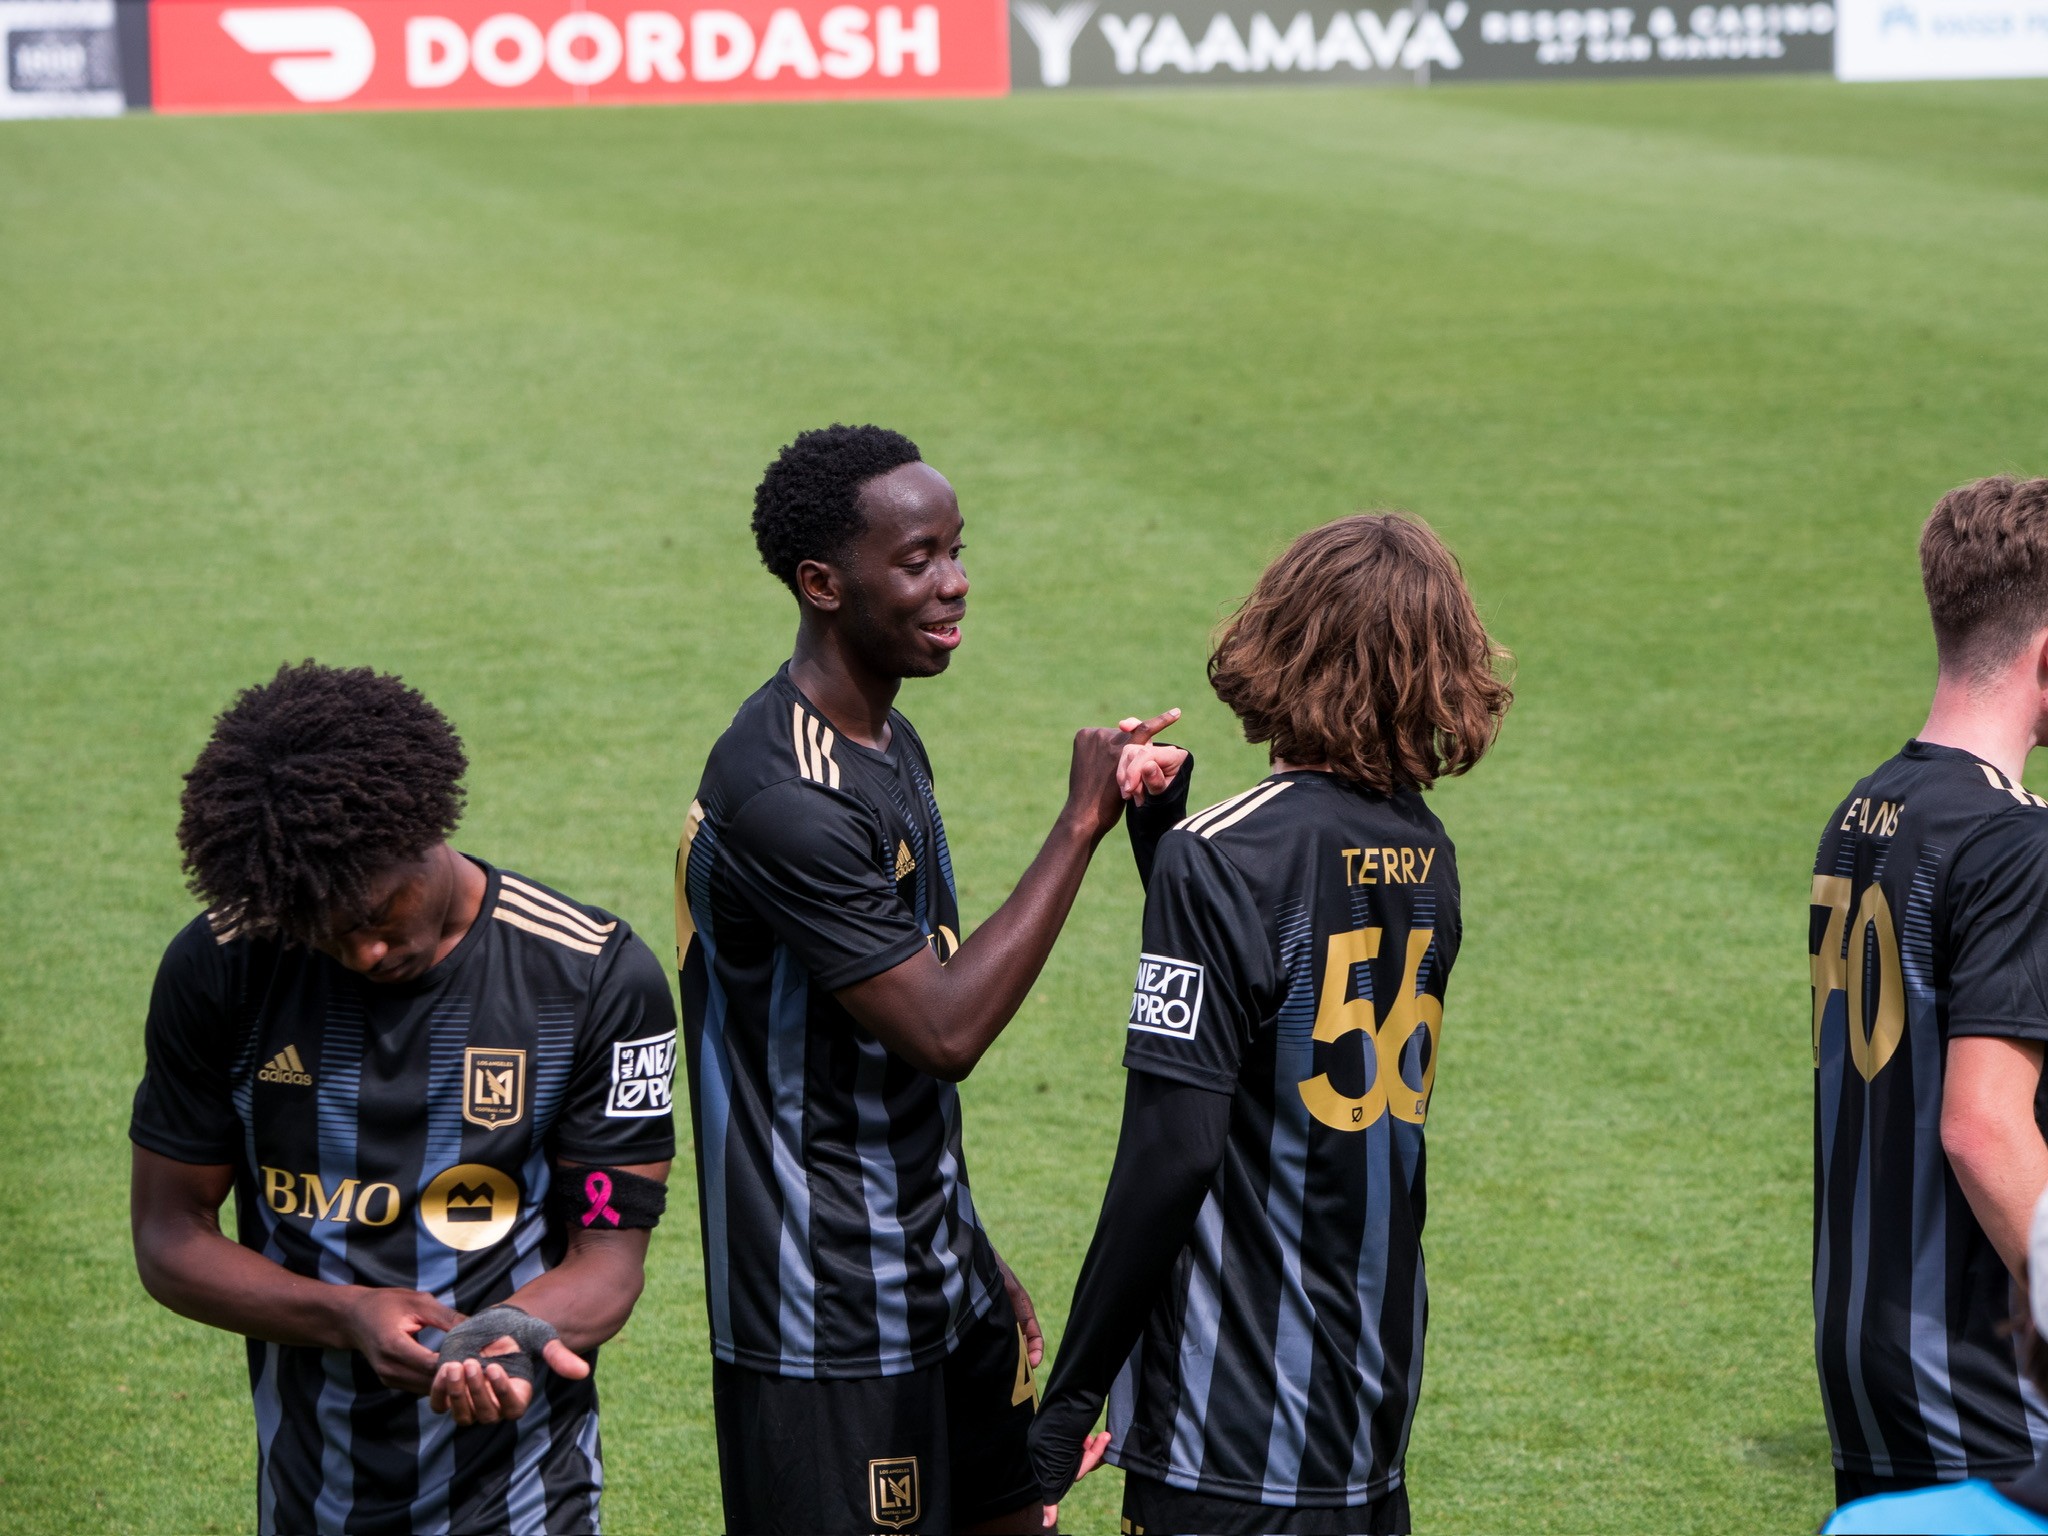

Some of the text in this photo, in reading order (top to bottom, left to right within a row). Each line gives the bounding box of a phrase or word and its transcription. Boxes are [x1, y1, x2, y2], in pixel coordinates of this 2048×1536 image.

[404, 4, 942, 89] DOORDASH
[1840, 798, 1905, 837] EANS
[1341, 847, 1436, 886] TERRY
[1135, 962, 1197, 998] NEXT
[1809, 874, 1906, 1084] 70
[1137, 993, 1191, 1029] PRO
[1298, 927, 1443, 1132] 56
[258, 1068, 312, 1086] adidas
[621, 1049, 634, 1080] MLS
[261, 1165, 400, 1226] BMO
